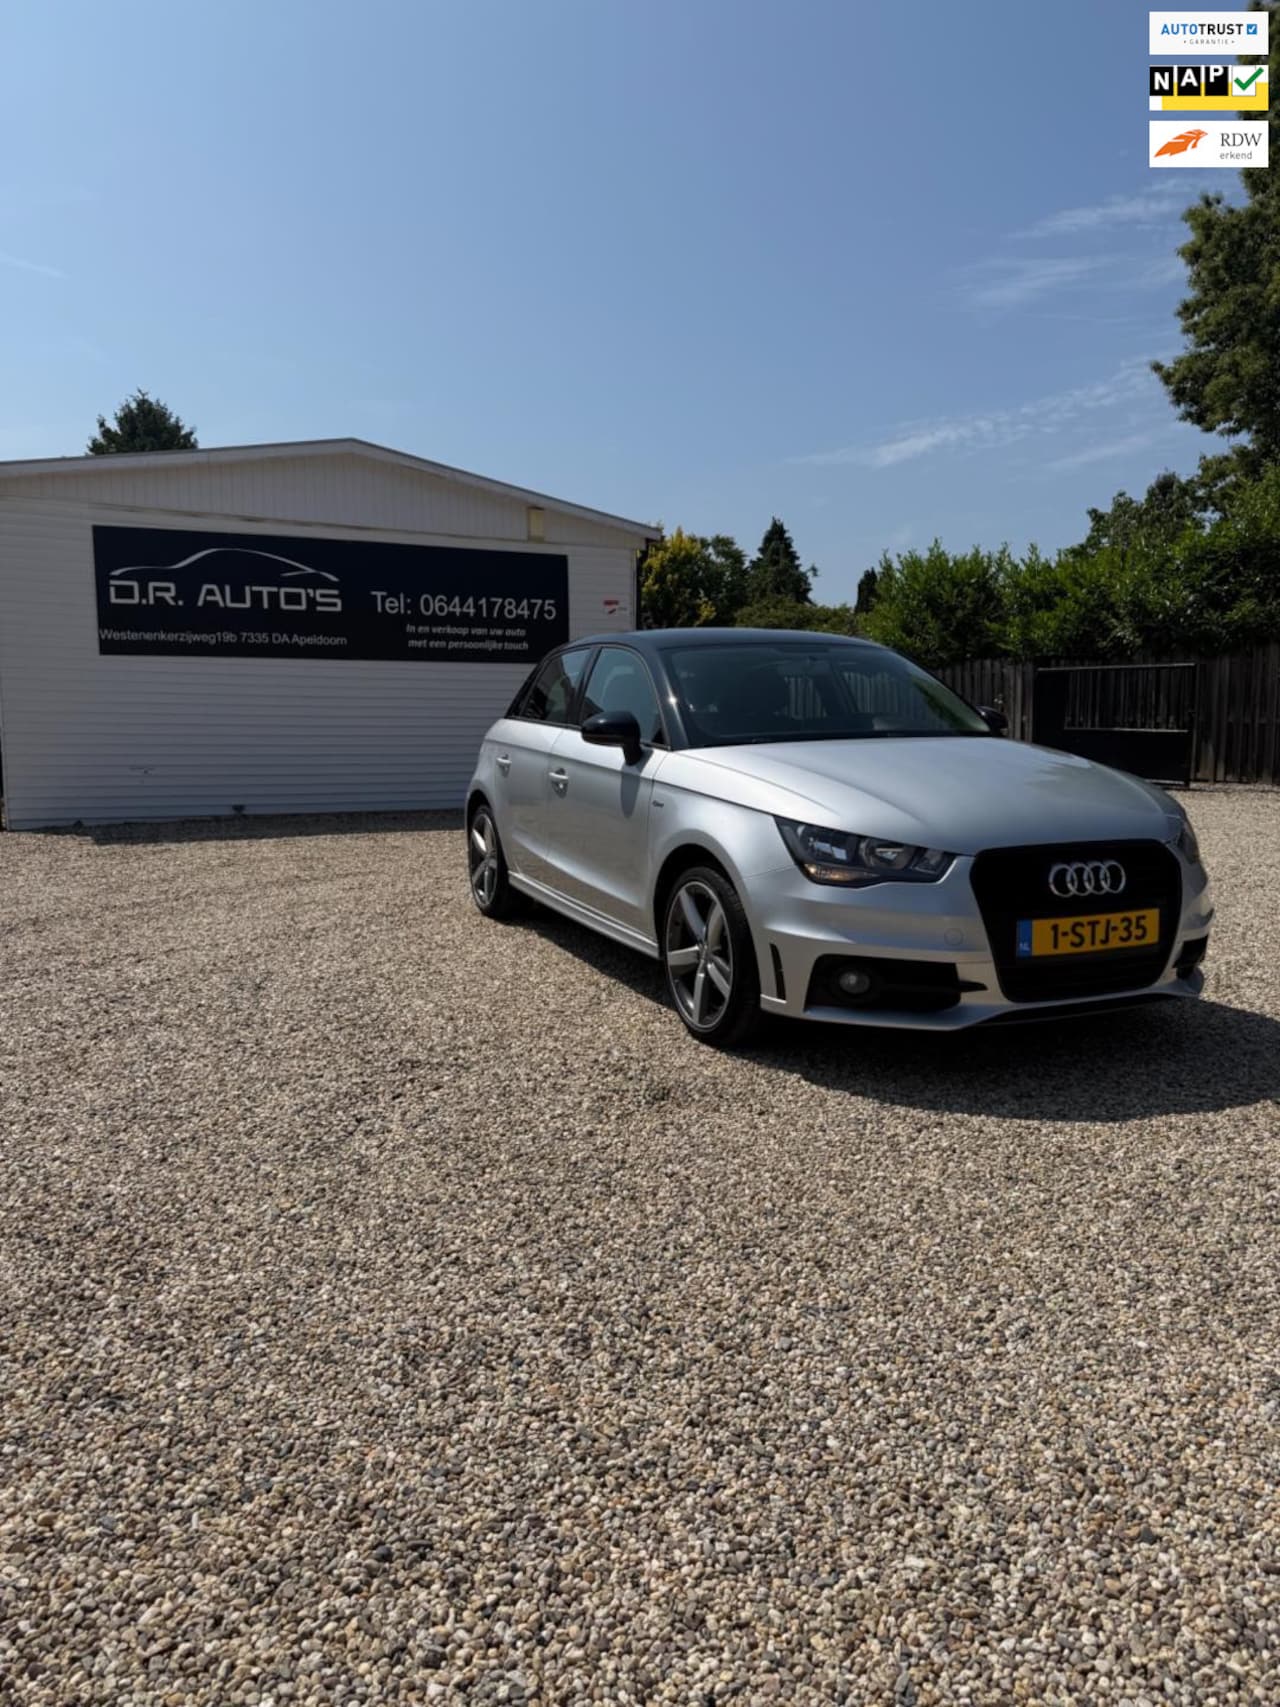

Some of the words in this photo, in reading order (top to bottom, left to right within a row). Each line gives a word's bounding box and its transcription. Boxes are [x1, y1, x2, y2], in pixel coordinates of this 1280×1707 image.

[109, 579, 183, 606] D.R.
[197, 584, 342, 612] AUTO'S
[370, 591, 412, 615] Tel:
[420, 593, 557, 620] 0644178475
[241, 632, 269, 645] 7335
[272, 633, 290, 645] DA
[292, 634, 348, 647] Apeldoorn
[406, 624, 415, 634] In
[418, 626, 429, 634] en
[432, 625, 469, 638] verkoop
[471, 627, 488, 636] van
[490, 628, 503, 637] uw
[505, 628, 526, 637] auto
[408, 639, 427, 648] met
[429, 640, 446, 649] een
[448, 639, 502, 651] persoonlijke
[504, 641, 529, 650] touch
[1051, 914, 1147, 950] 1-STJ-35
